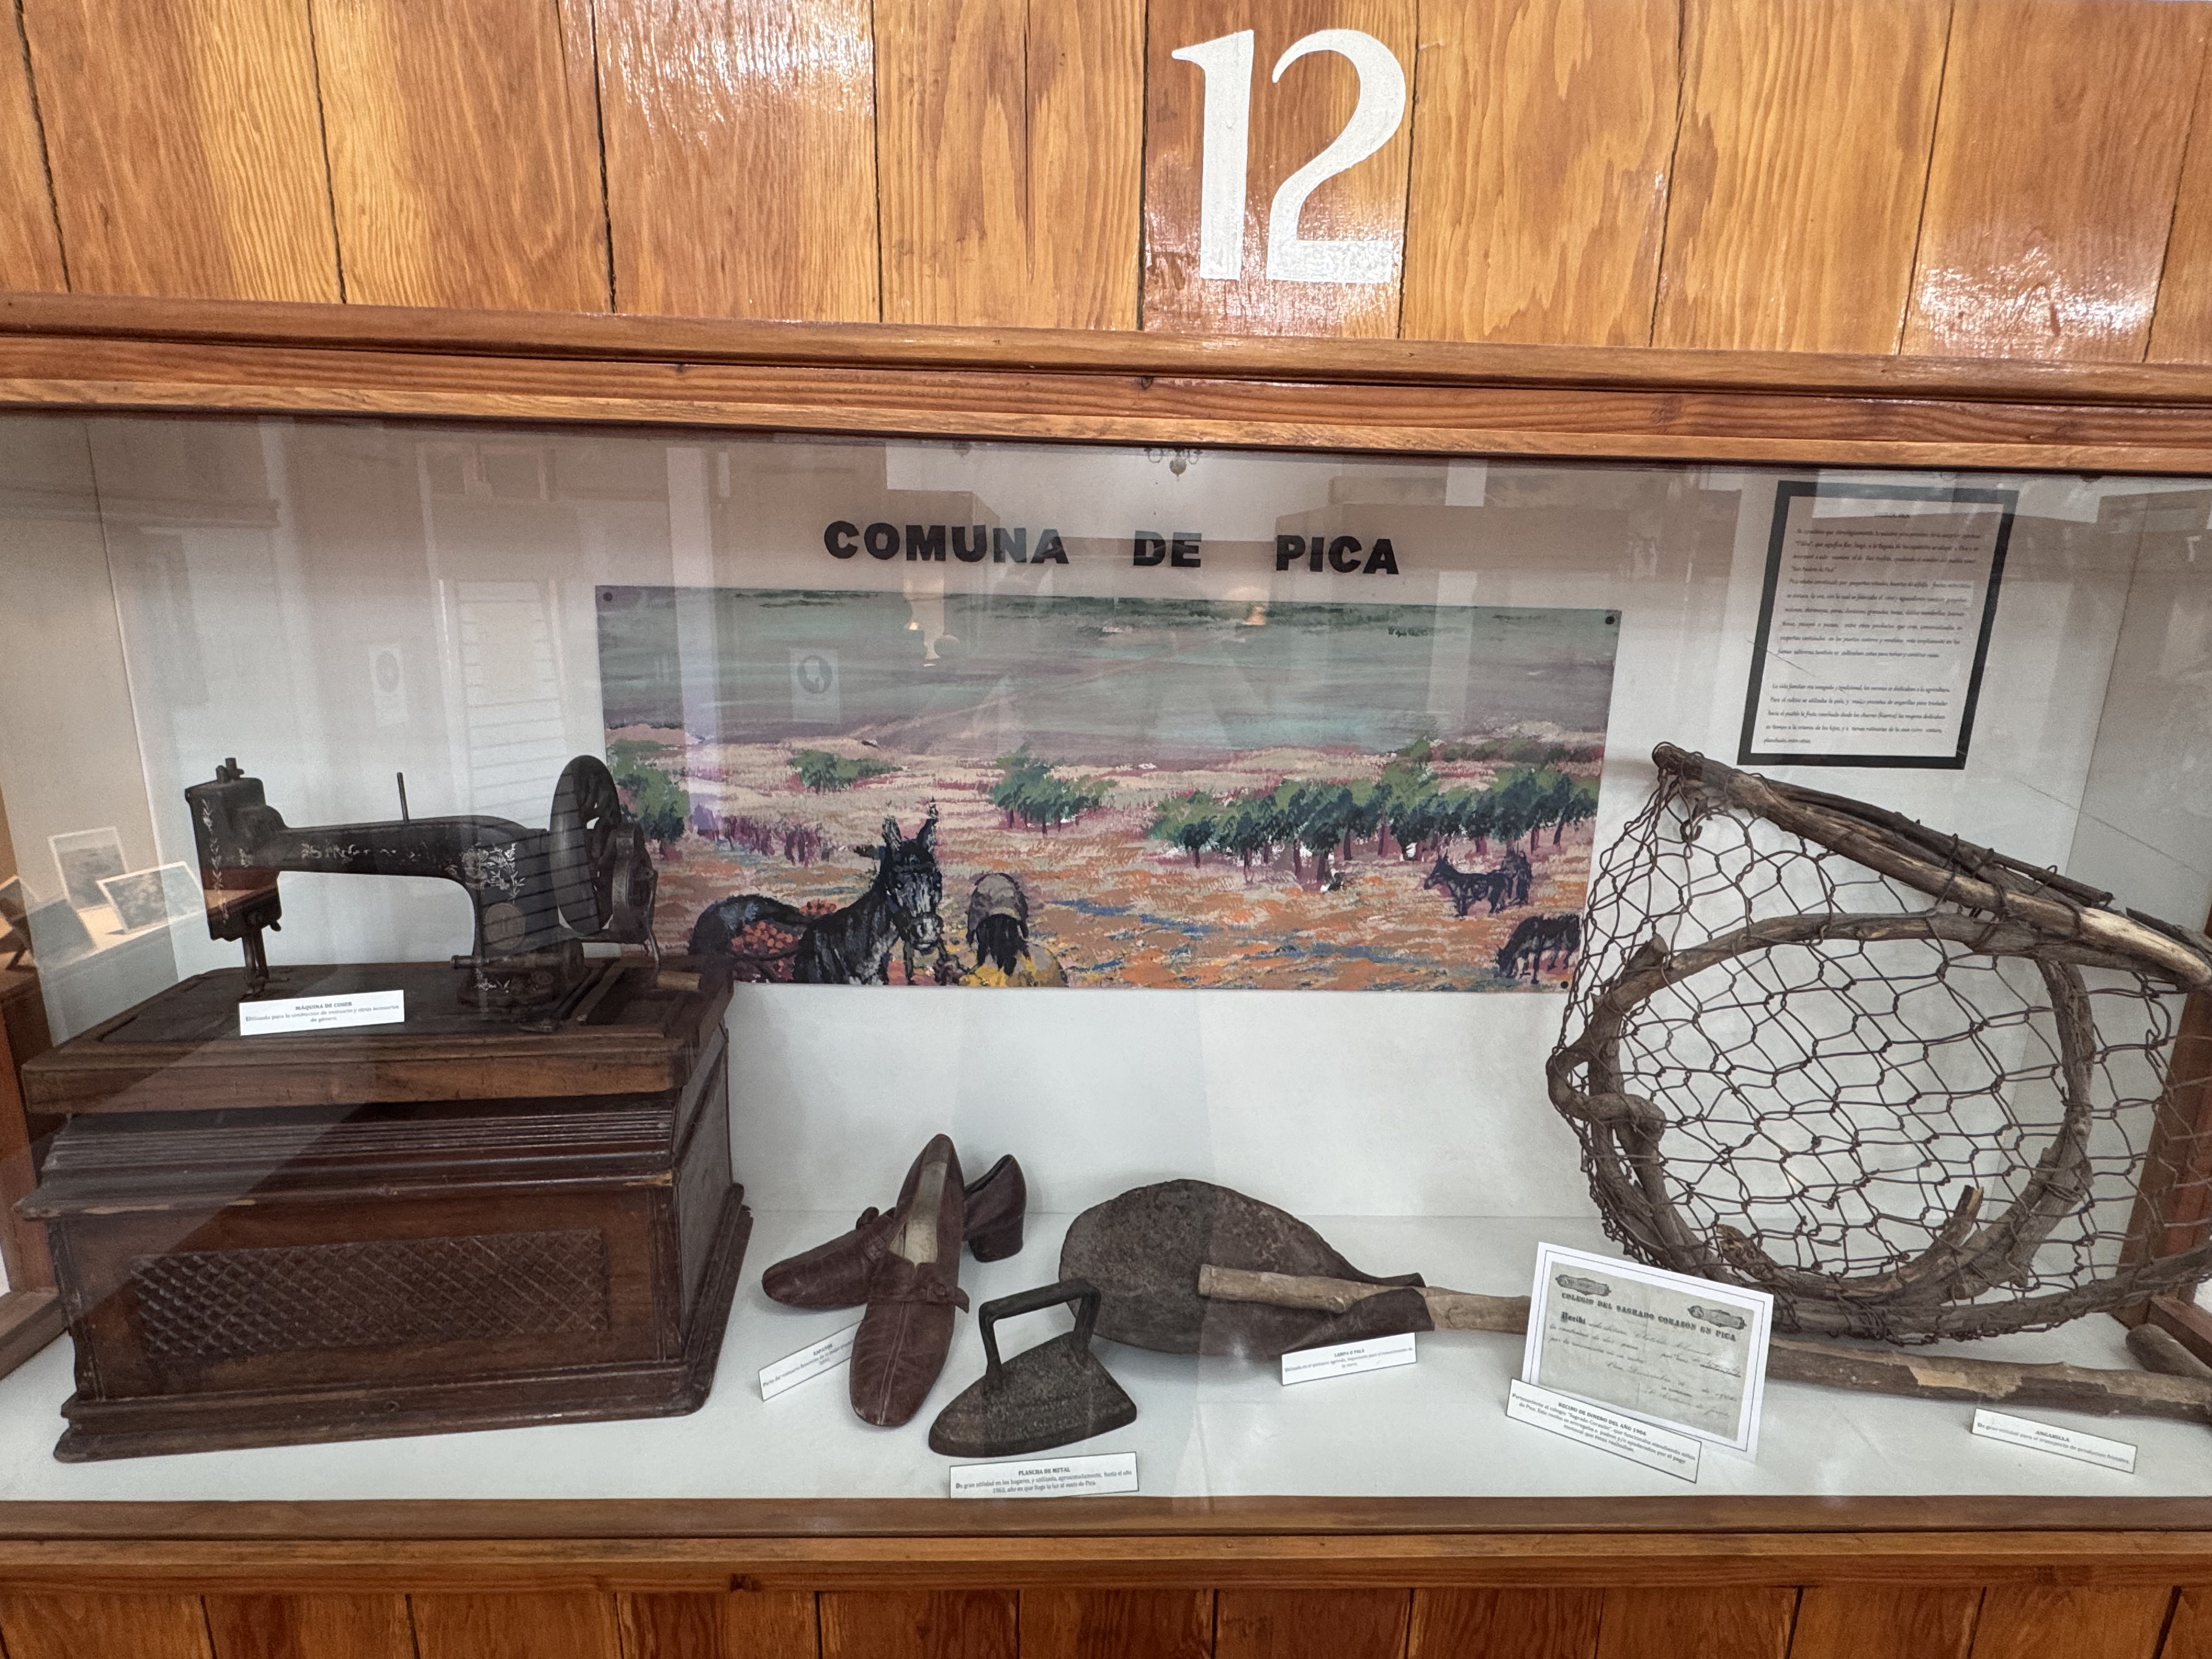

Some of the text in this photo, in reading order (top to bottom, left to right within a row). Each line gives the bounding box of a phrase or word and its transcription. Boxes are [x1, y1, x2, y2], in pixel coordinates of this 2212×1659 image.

[1172, 29, 1406, 283] 12
[824, 521, 1399, 574] COMUNA DE PICA
[1561, 1293, 1594, 1305] COLEGIO
[1616, 1305, 1655, 1321] SAGRADO
[1715, 1330, 1736, 1342] PICA
[1558, 1402, 1578, 1413] RECIBO
[1587, 1412, 1607, 1423] DINERO
